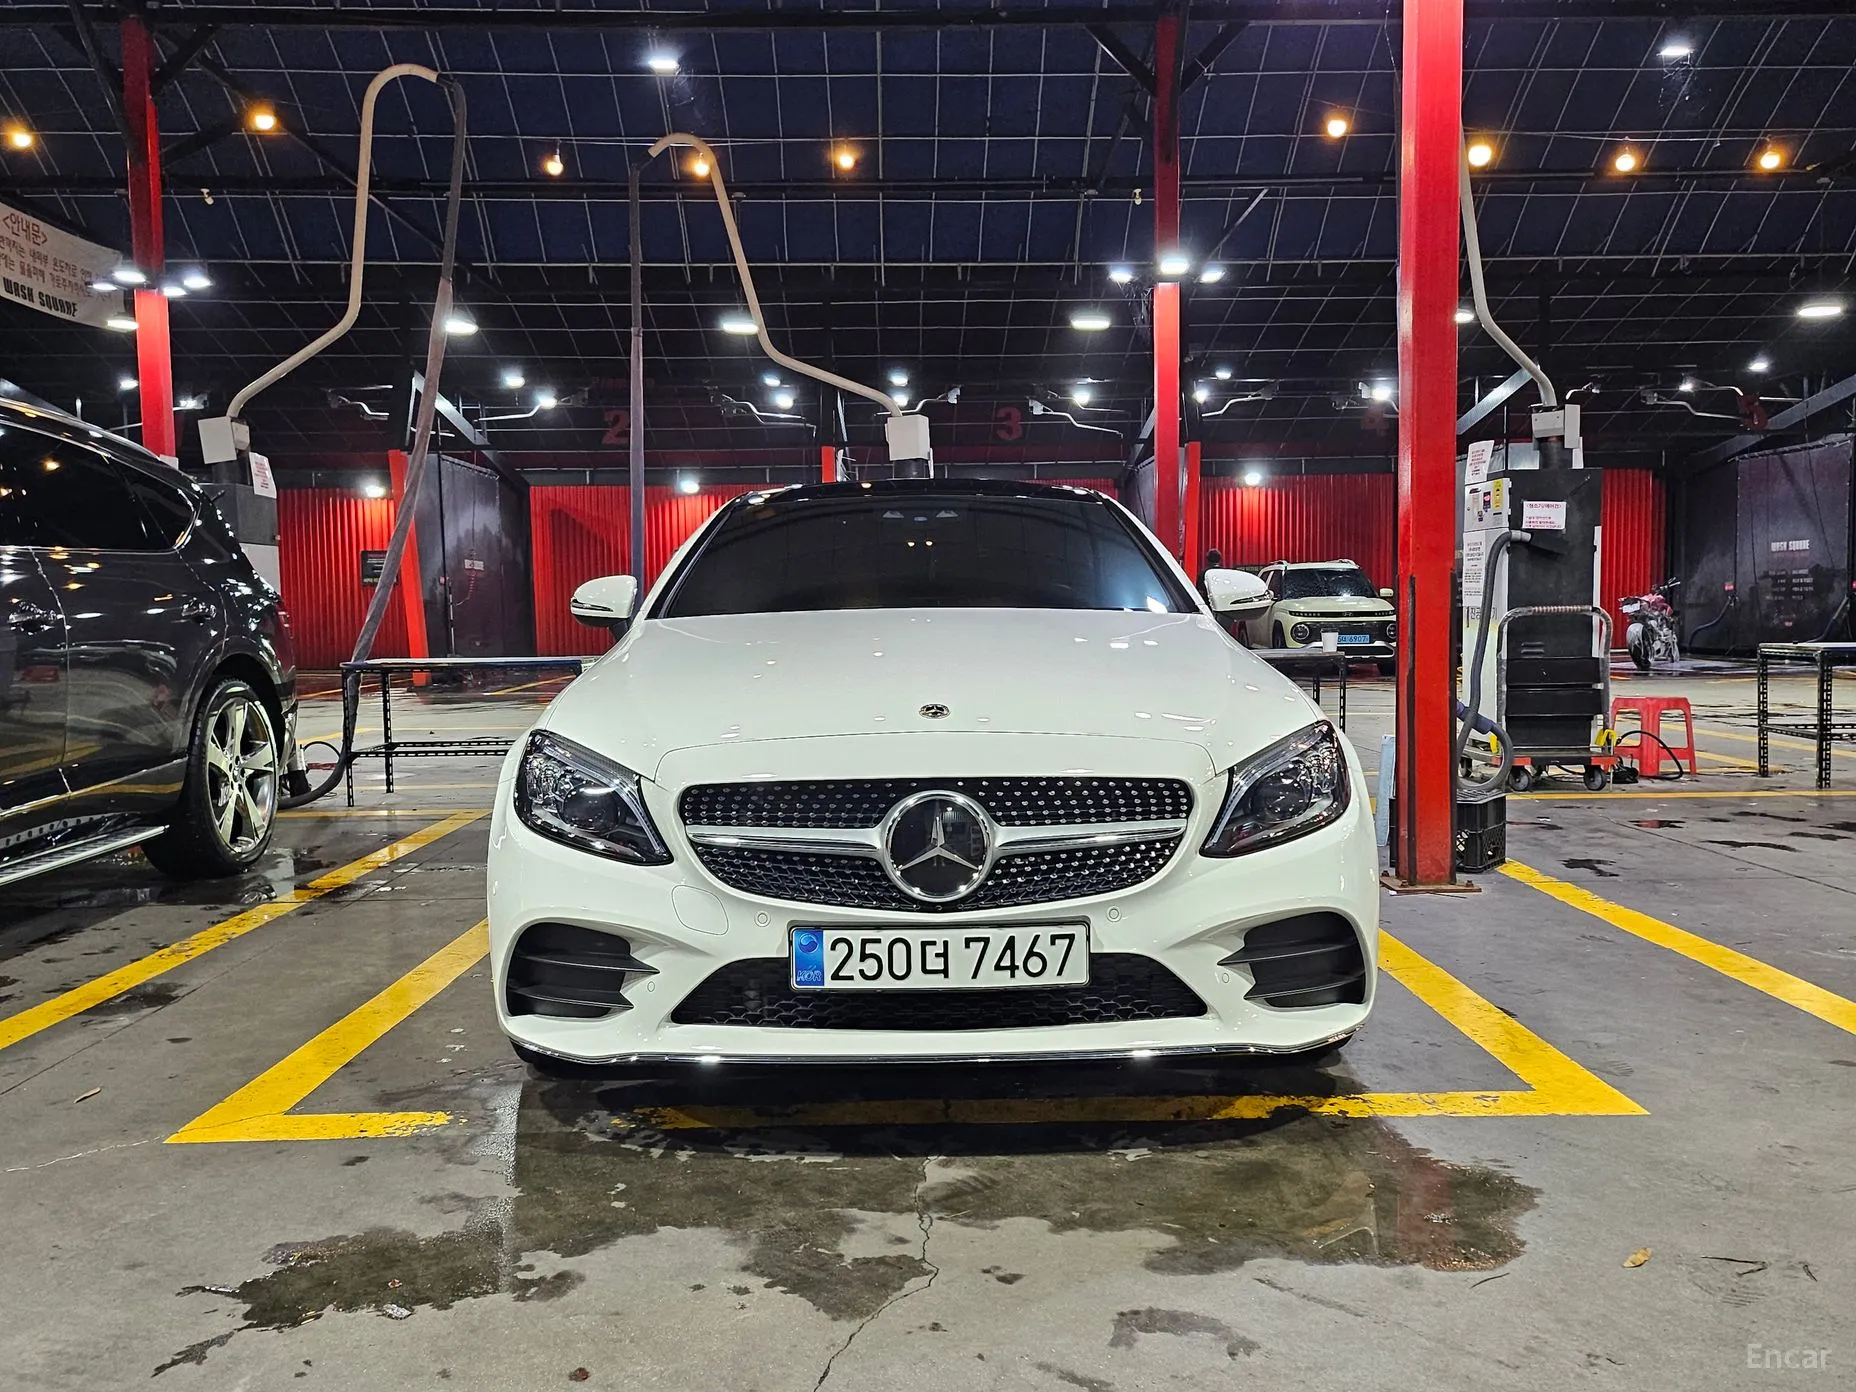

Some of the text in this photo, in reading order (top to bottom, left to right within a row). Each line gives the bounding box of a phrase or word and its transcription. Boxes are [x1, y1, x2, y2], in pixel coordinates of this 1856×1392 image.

[3, 213, 47, 246] <안내문>
[53, 257, 78, 278] 온도차로
[3, 276, 78, 317] WASH SQUARE
[602, 409, 630, 444] 2
[996, 407, 1022, 440] 3
[830, 934, 1076, 981] 250더 7467
[797, 969, 822, 982] KOR
